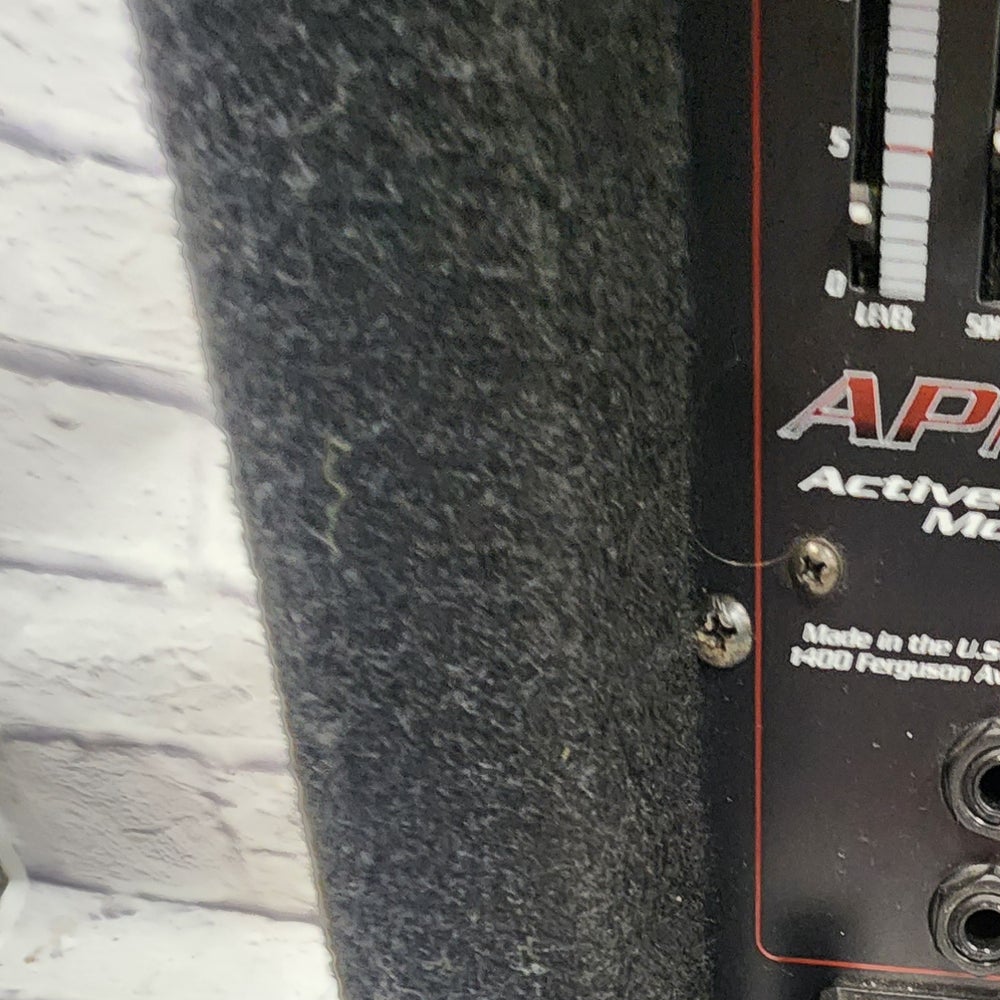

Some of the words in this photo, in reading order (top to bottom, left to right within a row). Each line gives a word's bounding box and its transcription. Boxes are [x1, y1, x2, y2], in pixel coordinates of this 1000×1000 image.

[825, 269, 847, 299] 0
[802, 622, 873, 650] Made
[876, 630, 903, 652] in
[908, 633, 953, 657] the
[856, 652, 971, 681] Ferguson
